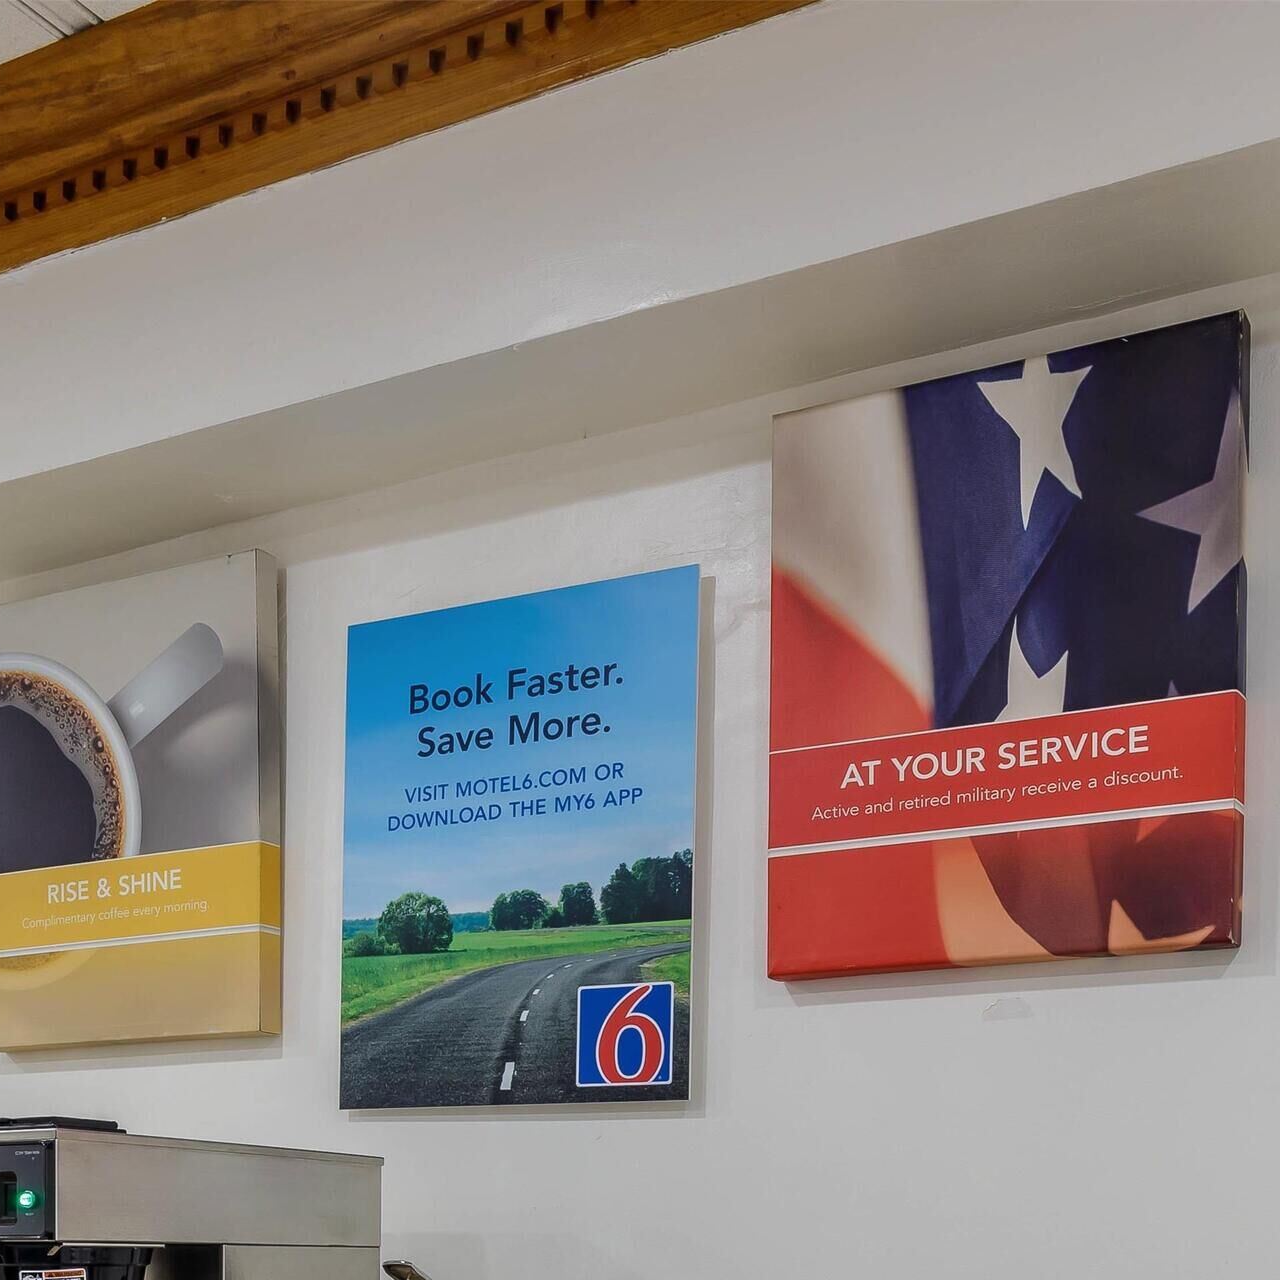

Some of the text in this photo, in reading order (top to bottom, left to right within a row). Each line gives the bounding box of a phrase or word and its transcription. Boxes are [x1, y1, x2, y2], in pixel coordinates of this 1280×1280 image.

[409, 663, 624, 714] Book Faster.
[417, 712, 611, 758] Save More.
[840, 725, 1149, 789] AT YOUR SERVICE
[404, 762, 625, 803] VISIT MOTEL6.COM OR
[811, 765, 1184, 821] Active and retired military receive a discount.
[387, 787, 643, 832] DOWNLOAD THE MY6 APP
[47, 869, 182, 904] RISE & SHINE
[22, 909, 96, 929] Complimentary
[98, 907, 130, 921] coffee
[132, 904, 161, 918] every
[595, 983, 665, 1085] 6
